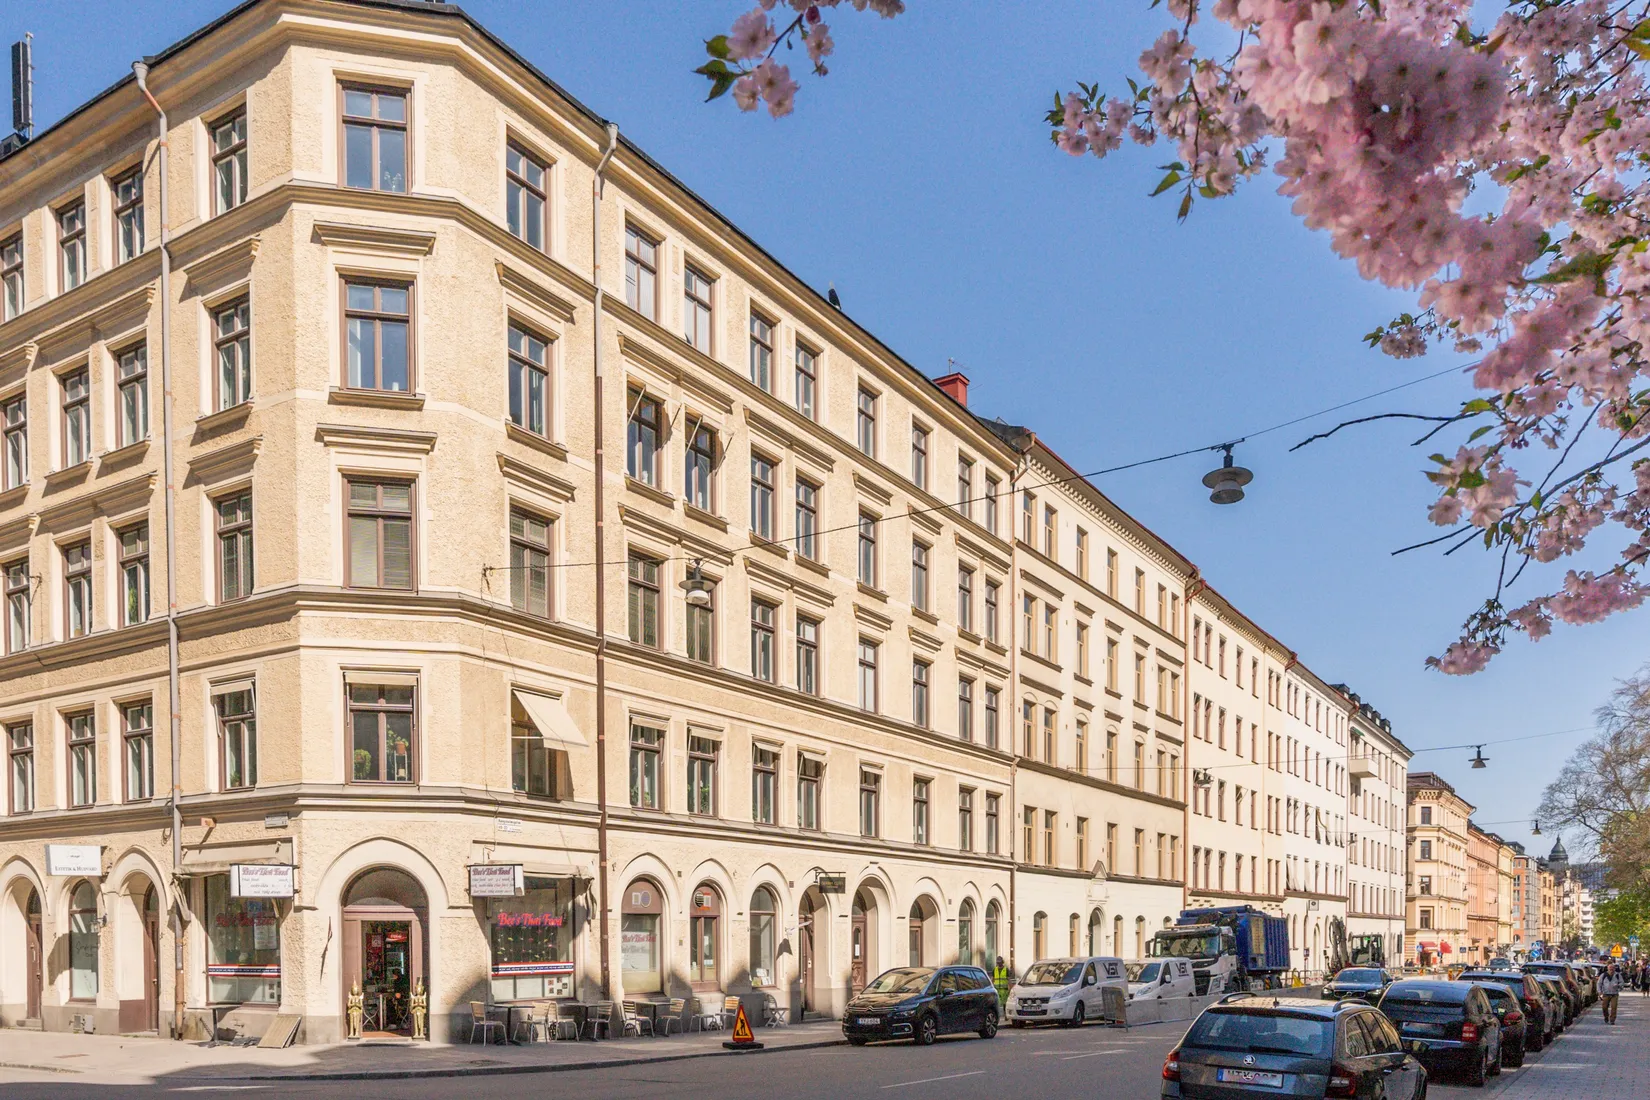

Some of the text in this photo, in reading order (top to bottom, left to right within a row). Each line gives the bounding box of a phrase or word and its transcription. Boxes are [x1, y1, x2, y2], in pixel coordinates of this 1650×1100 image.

[497, 911, 562, 926] Bee's Thai Food
